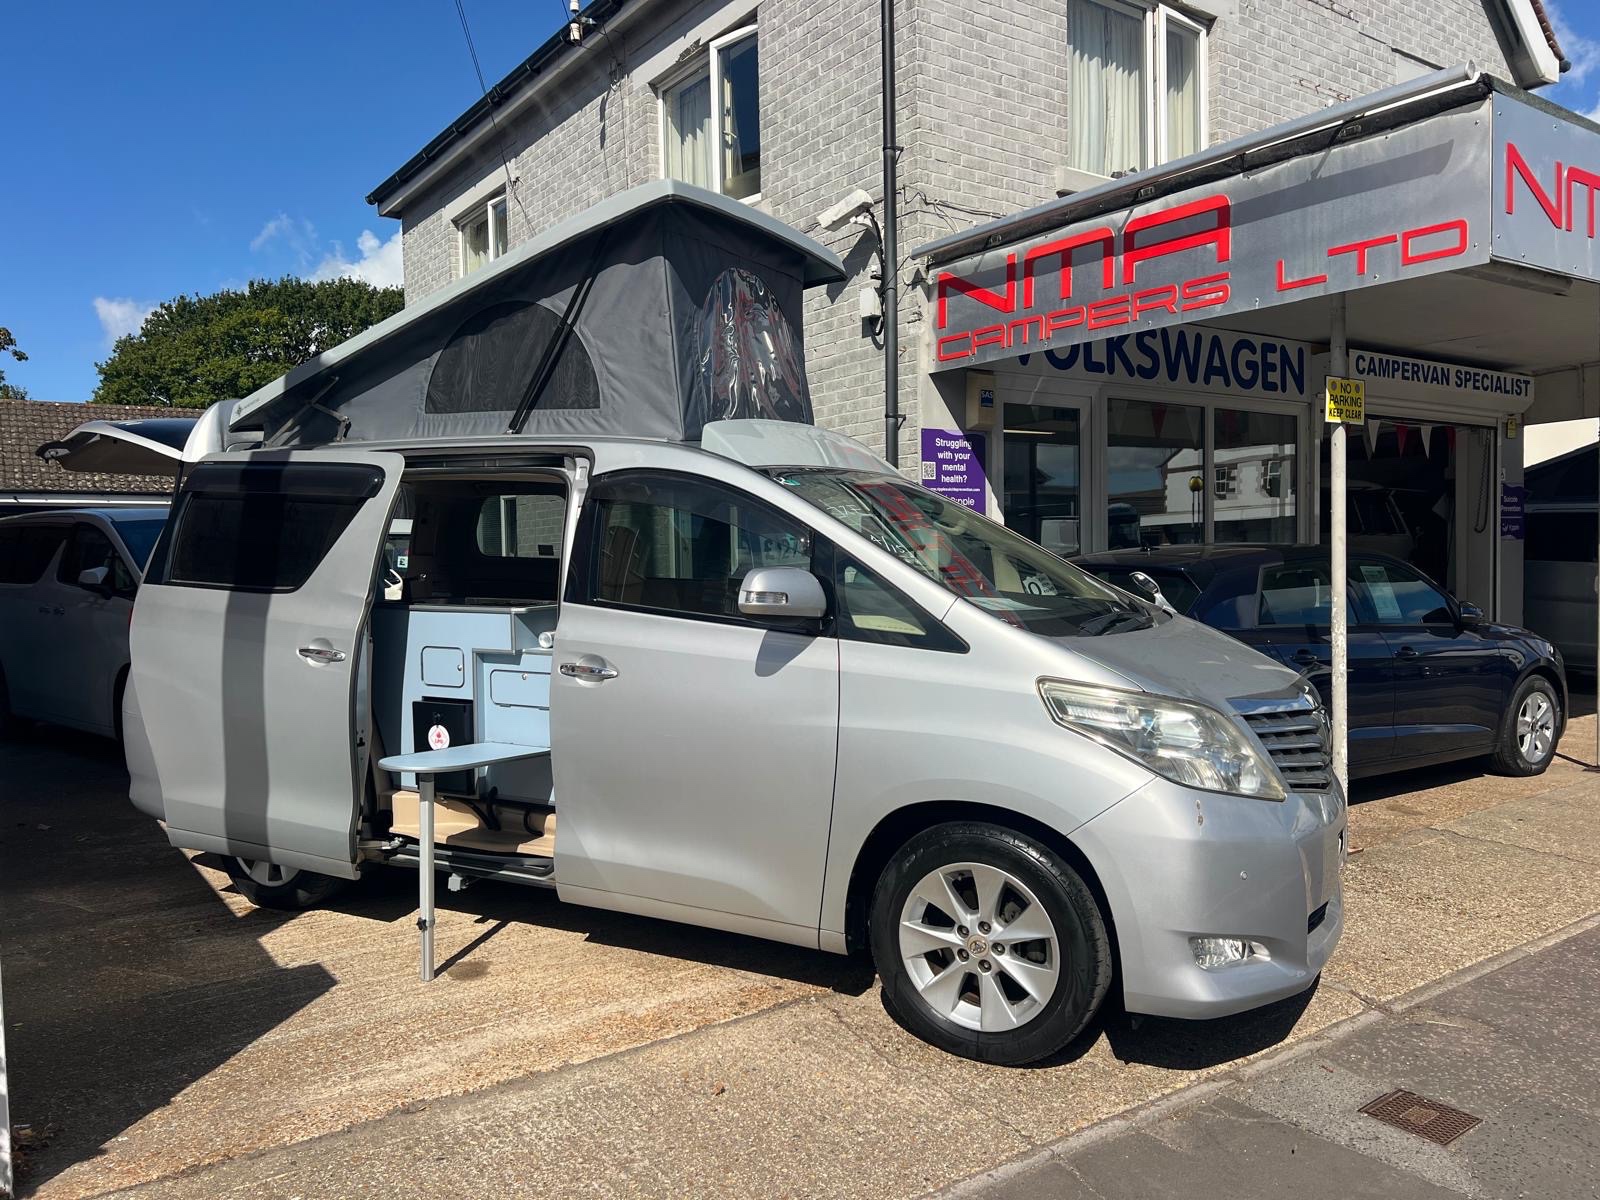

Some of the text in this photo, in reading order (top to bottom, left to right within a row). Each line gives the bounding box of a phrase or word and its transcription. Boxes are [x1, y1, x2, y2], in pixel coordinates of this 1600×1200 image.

[937, 194, 1231, 330] NMA
[937, 219, 1469, 362] CAMPERS LTD
[1018, 327, 1305, 396] LKSWAGEN
[1355, 354, 1531, 398] CAMPERVAN SPECIALIST
[1340, 382, 1352, 394] NO
[981, 390, 993, 399] SAS
[1329, 394, 1362, 408] PARKING
[1329, 408, 1362, 420] KEEP CLEAR
[935, 438, 972, 449] Struggling
[937, 451, 971, 462] with your
[942, 463, 967, 472] mental
[941, 474, 968, 484] health?
